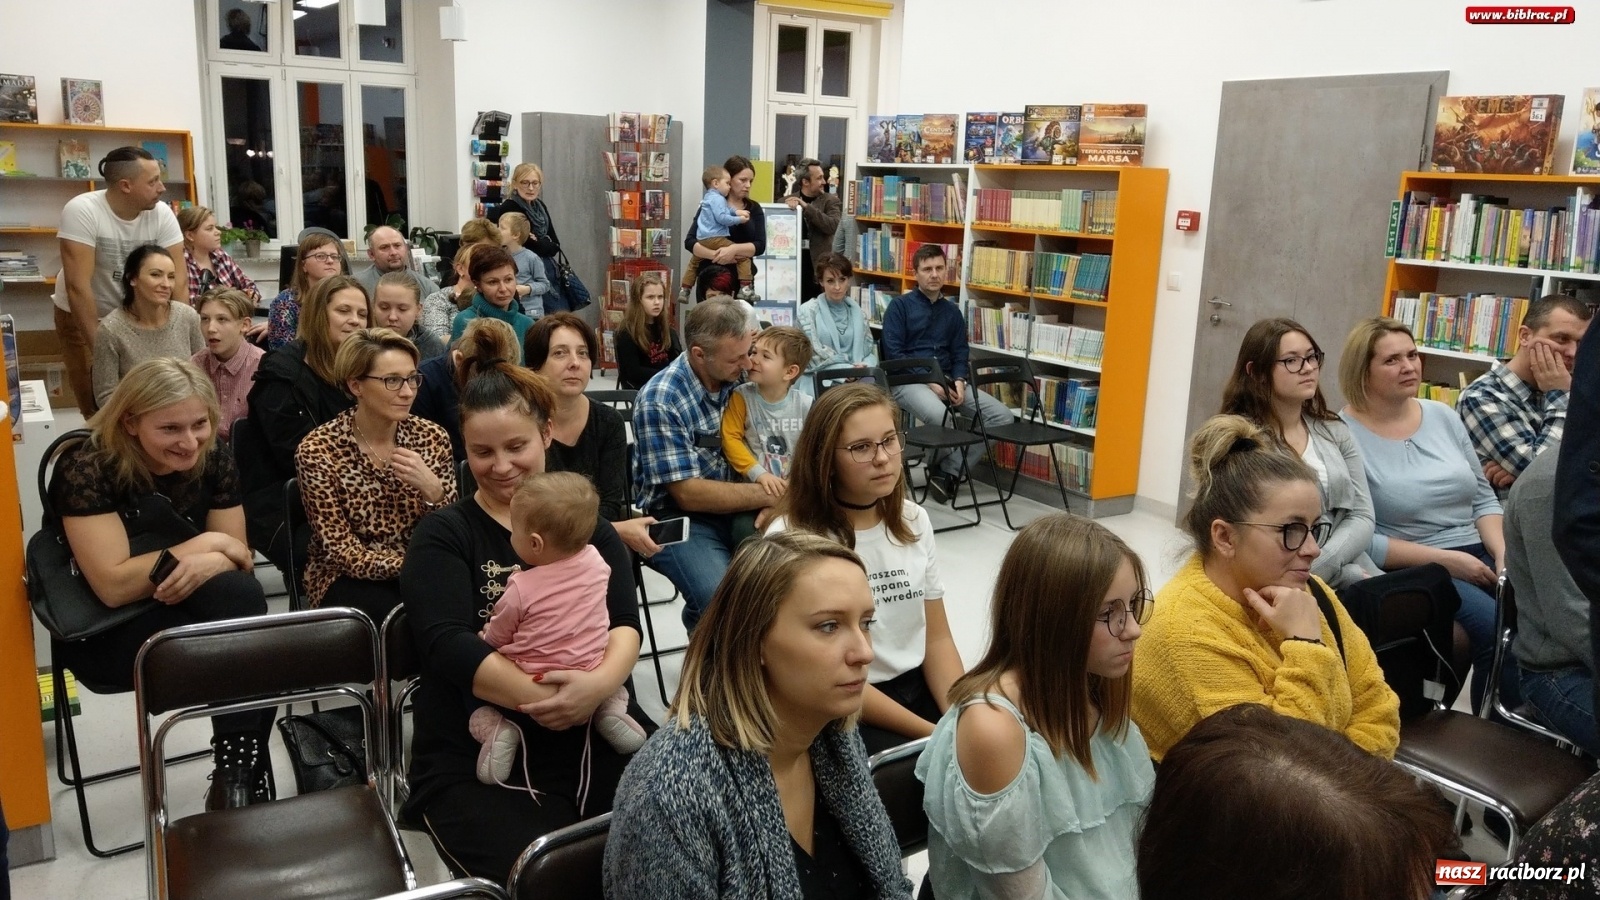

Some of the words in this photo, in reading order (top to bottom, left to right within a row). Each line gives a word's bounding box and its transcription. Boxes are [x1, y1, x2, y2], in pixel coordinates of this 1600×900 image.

[1088, 155, 1130, 163] MARSA
[1391, 205, 1399, 227] LAT
[1388, 231, 1396, 253] 8-11
[868, 568, 909, 582] raszam,
[883, 589, 924, 604] wredna
